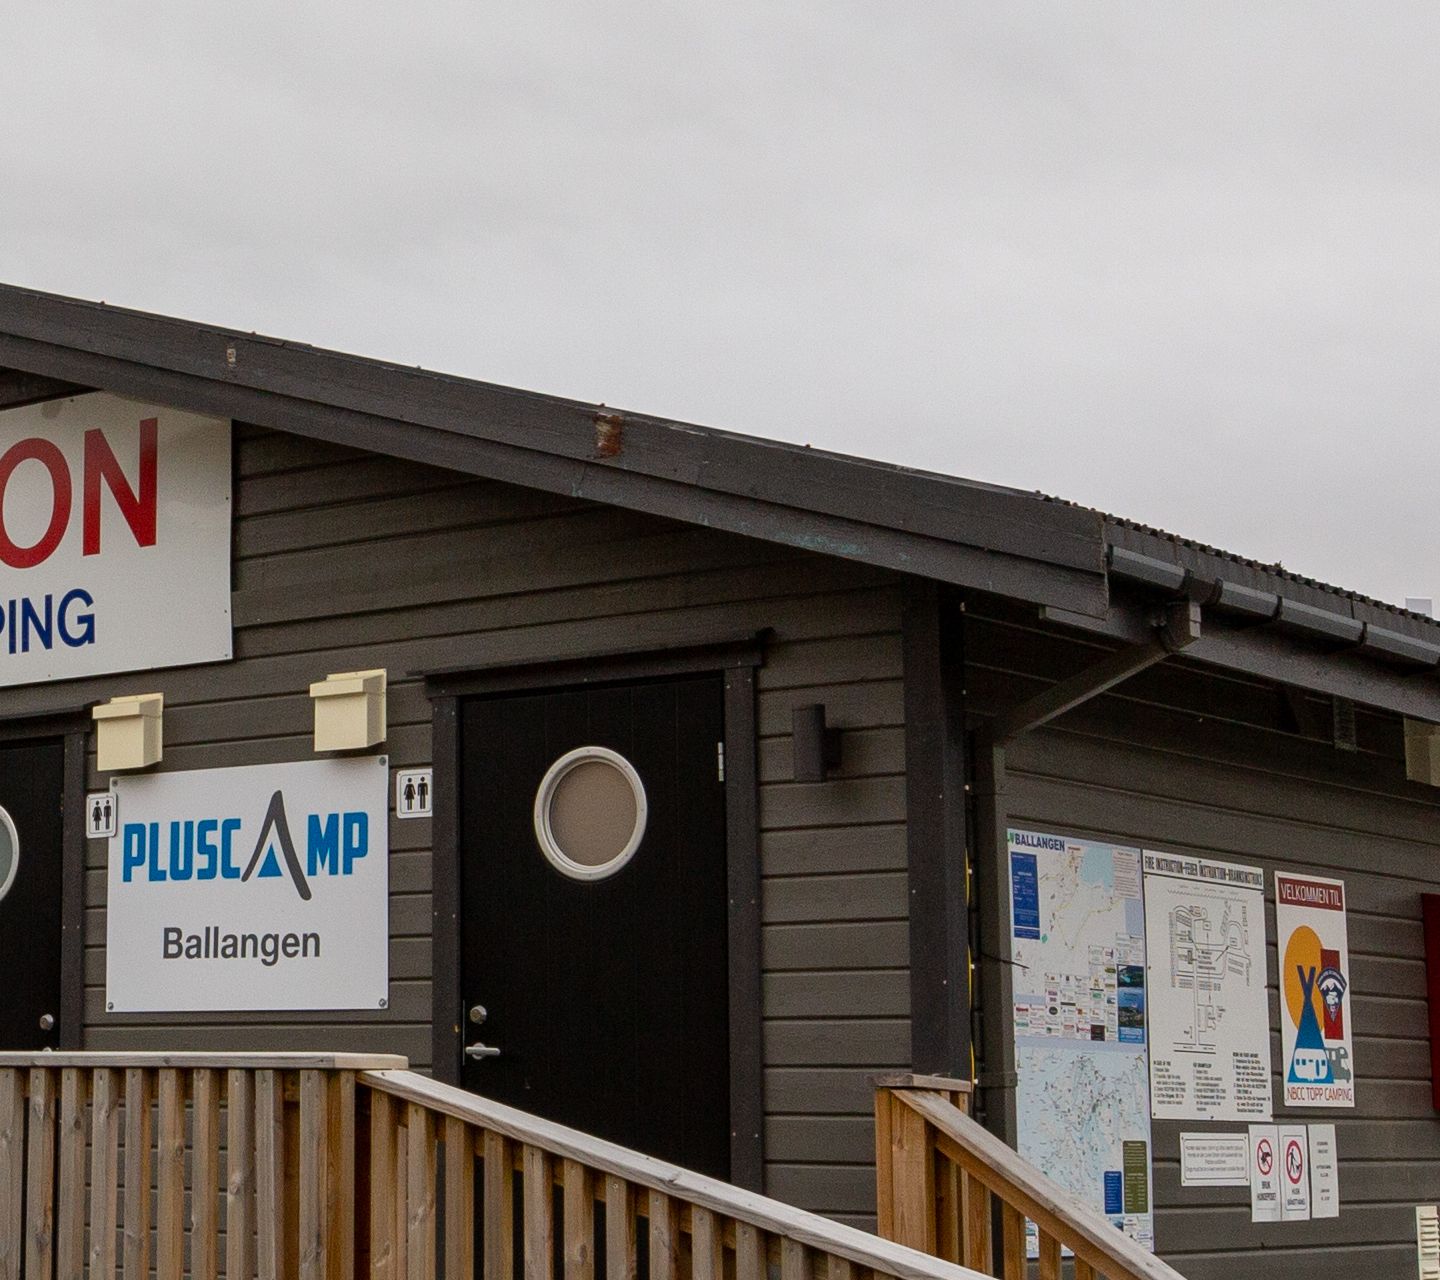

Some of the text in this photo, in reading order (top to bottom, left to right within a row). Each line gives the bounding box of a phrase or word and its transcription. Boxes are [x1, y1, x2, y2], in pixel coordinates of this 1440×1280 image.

[122, 789, 369, 902] PLUSCAMP
[1014, 833, 1066, 852] BALLANGEN
[1280, 882, 1341, 907] VELKOMMEN TIL
[162, 925, 321, 967] Ballangen
[1287, 1086, 1353, 1102] NBCC TOPP CAMPING
